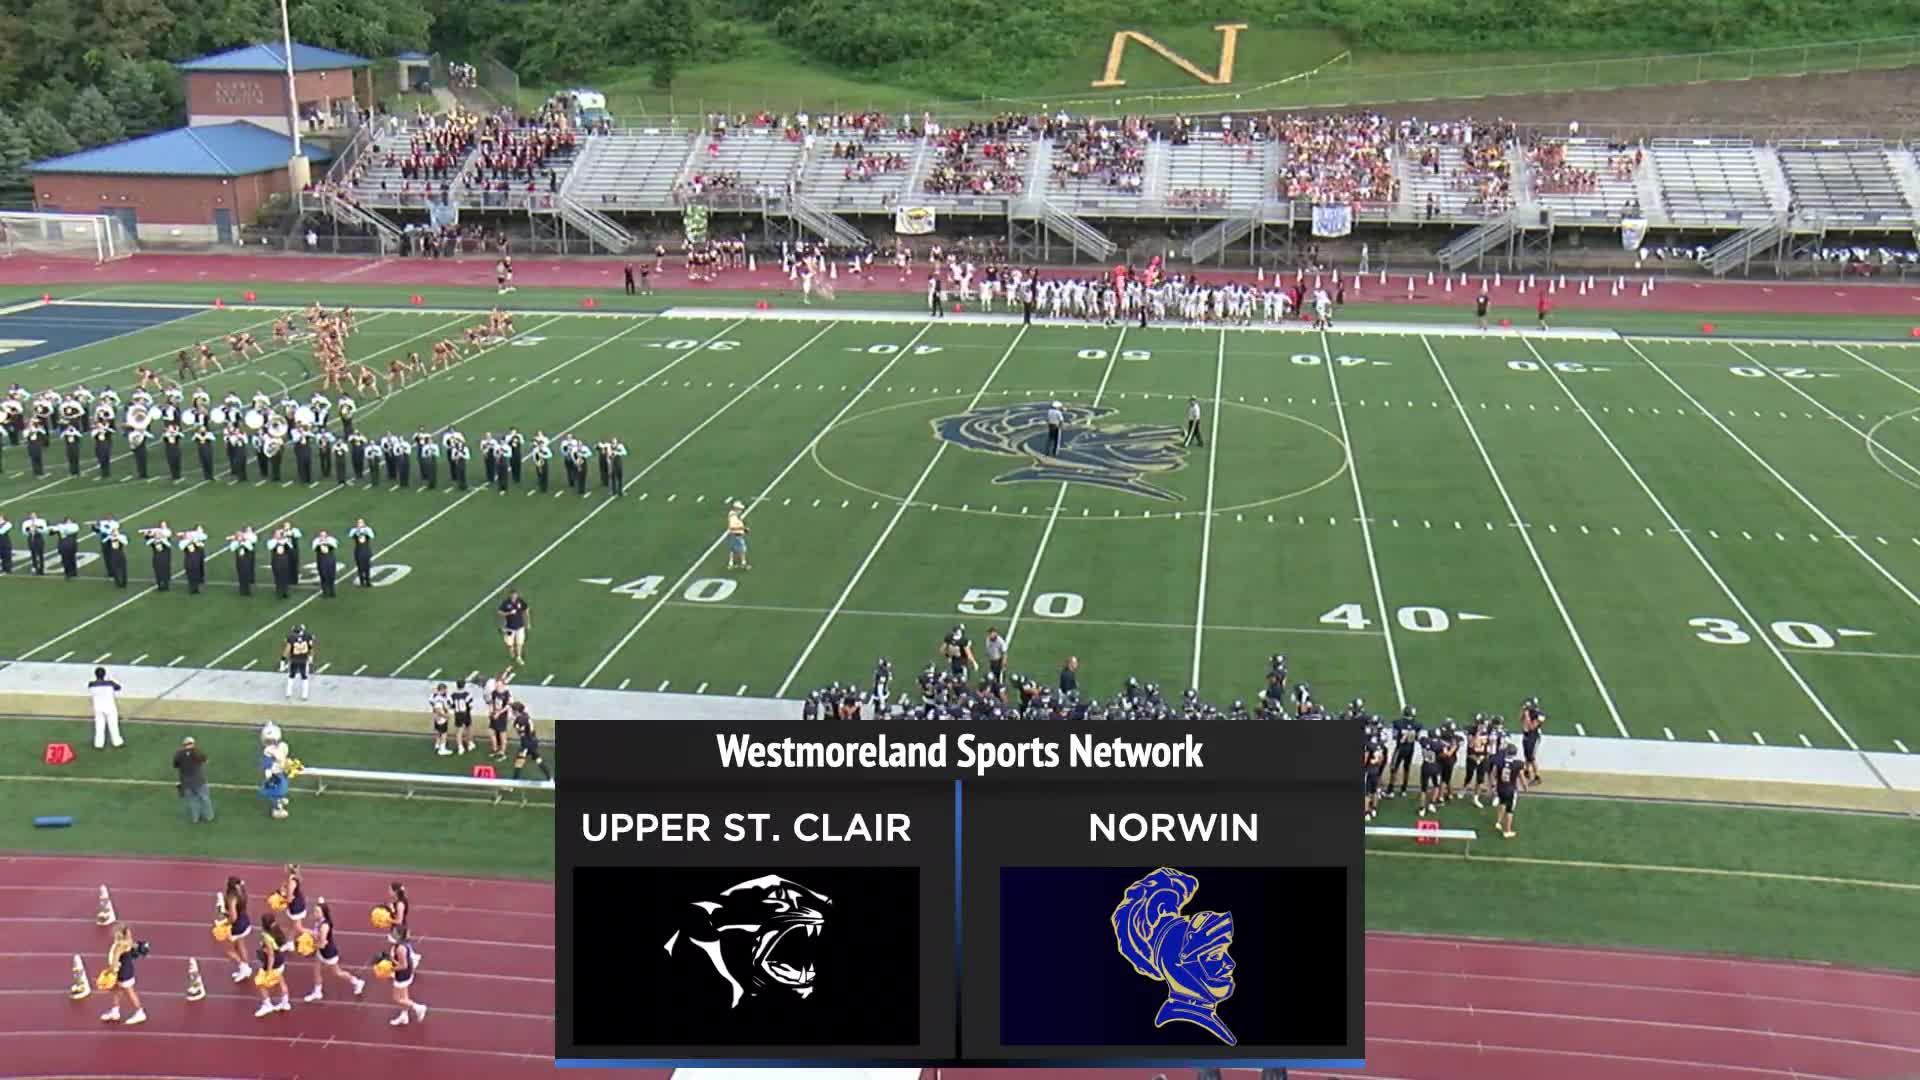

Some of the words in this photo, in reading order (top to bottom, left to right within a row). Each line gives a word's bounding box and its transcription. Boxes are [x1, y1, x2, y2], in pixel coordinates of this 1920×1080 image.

[1090, 23, 1249, 87] N
[610, 575, 738, 602] 40
[957, 588, 1084, 618] 50
[1319, 603, 1449, 632] 40
[1687, 617, 1835, 648] 30
